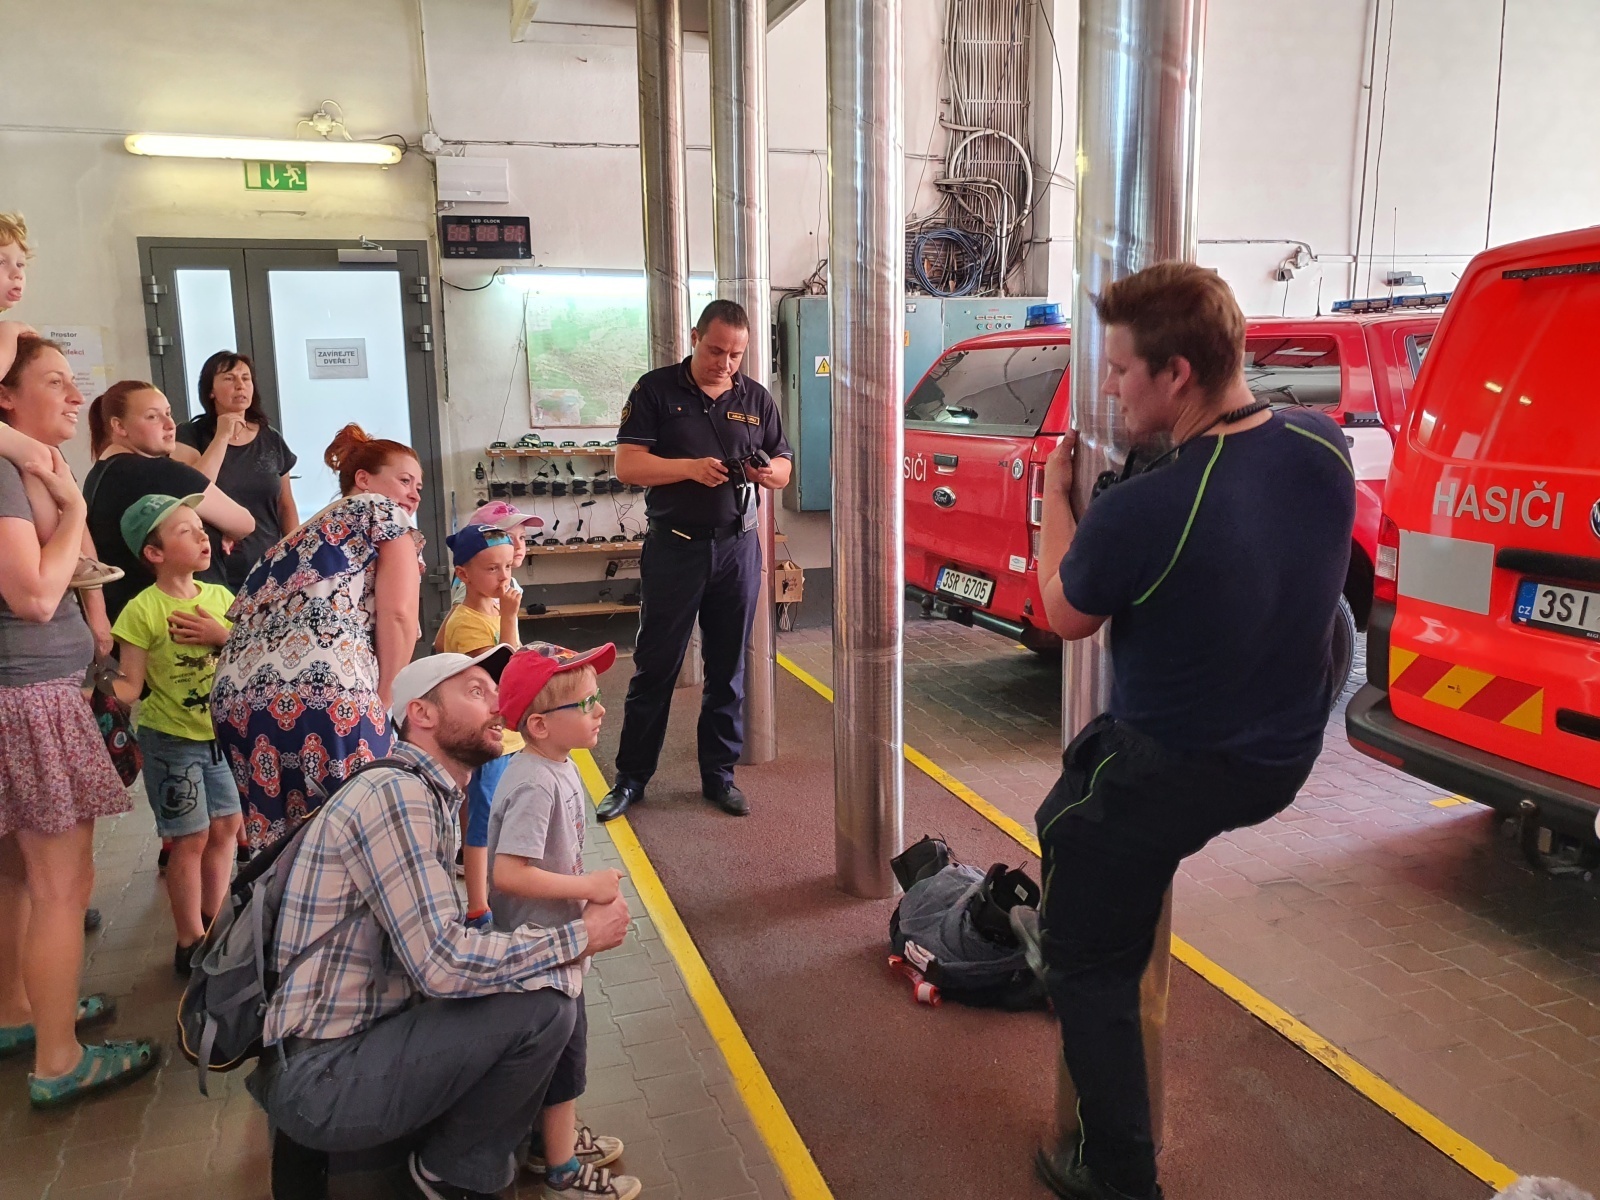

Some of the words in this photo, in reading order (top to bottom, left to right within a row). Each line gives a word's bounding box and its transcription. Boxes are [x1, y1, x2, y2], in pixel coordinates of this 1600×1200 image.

[317, 350, 356, 358] ZAVÍREJTE
[323, 357, 347, 365] DVEŘE
[903, 452, 927, 482] SIČI
[1432, 480, 1565, 530] HASIČI
[942, 571, 960, 592] 3SR
[963, 577, 989, 600] 6705
[1518, 605, 1532, 615] CZ
